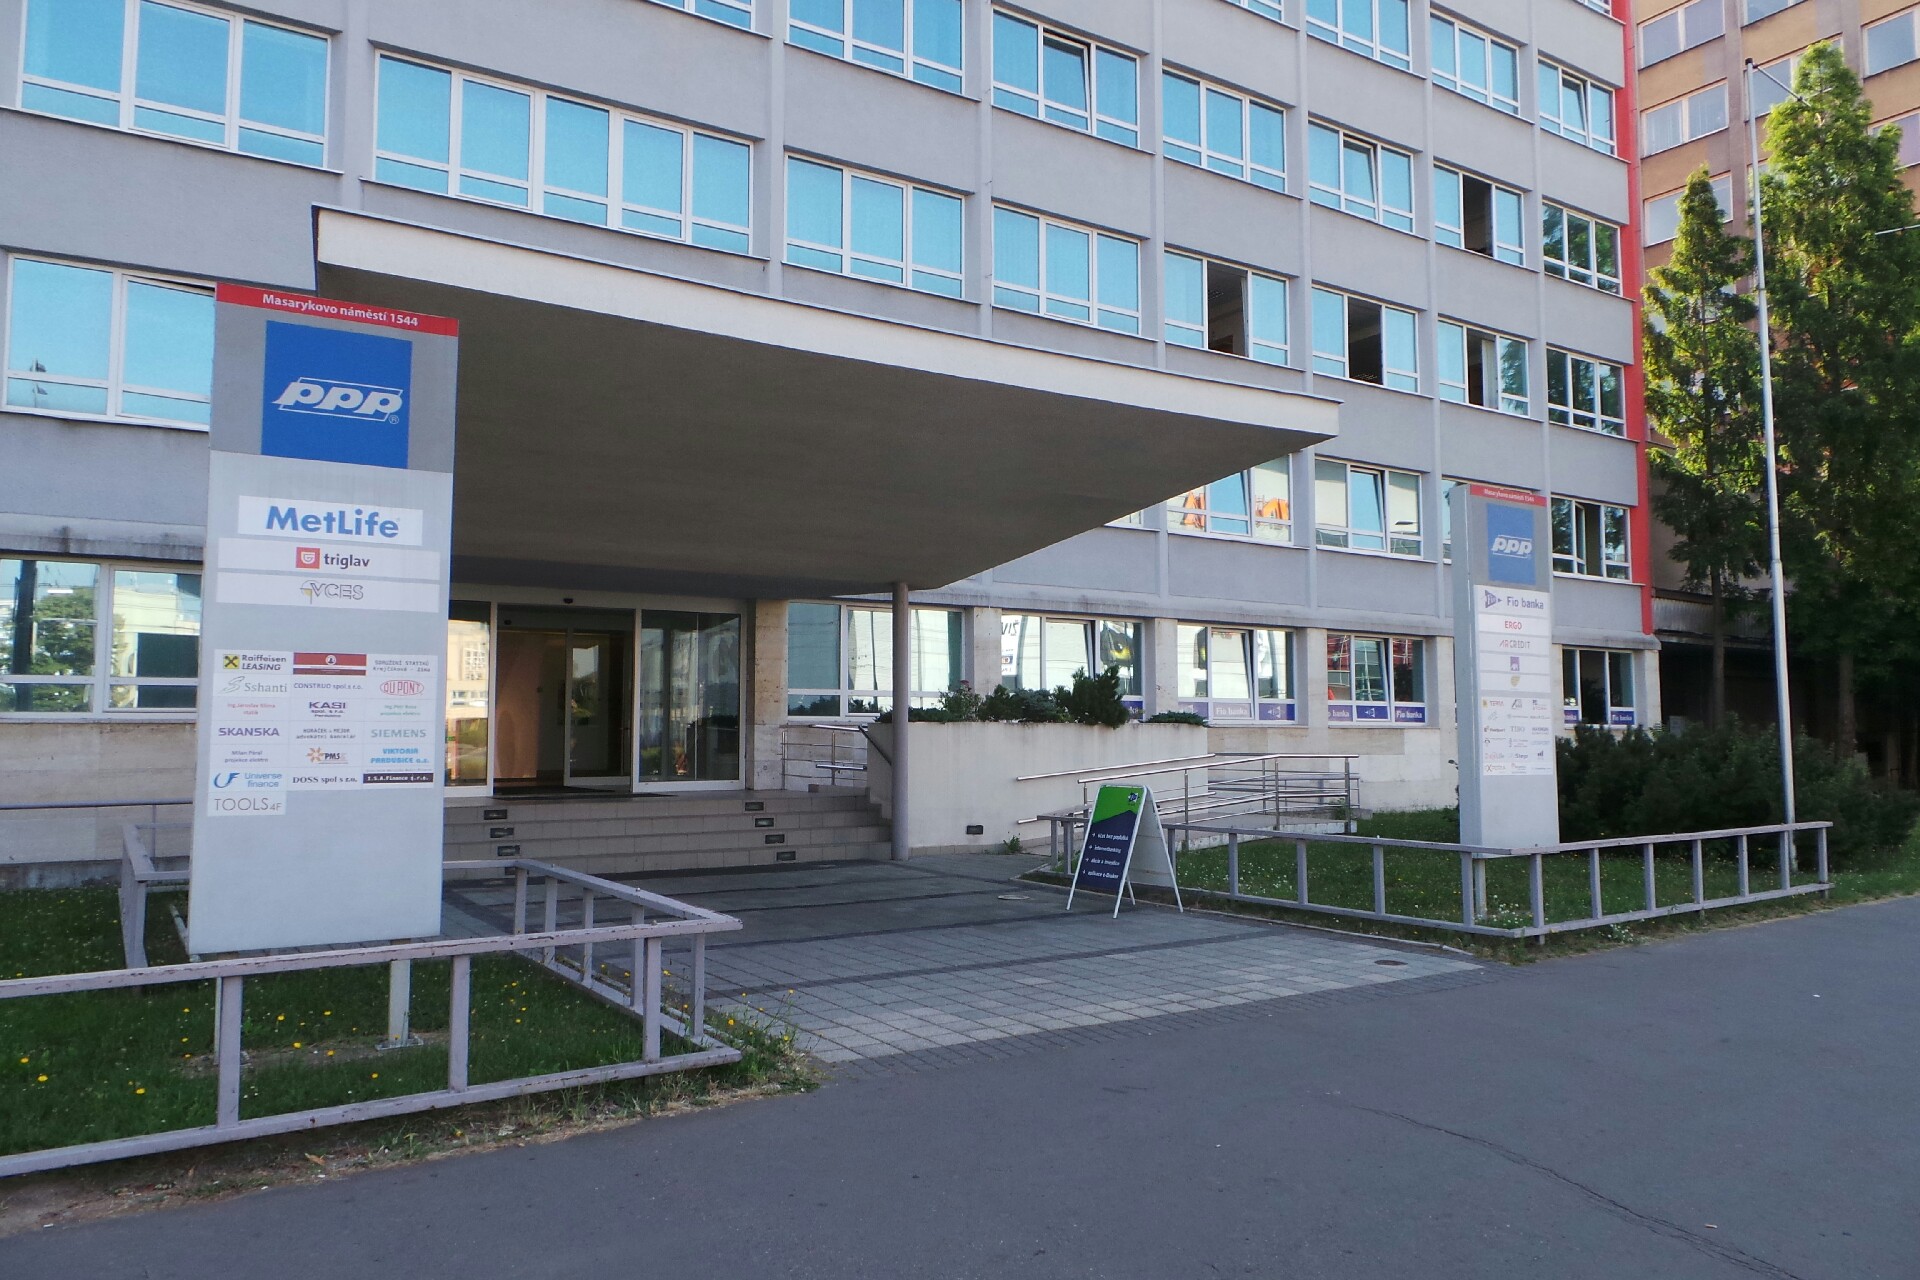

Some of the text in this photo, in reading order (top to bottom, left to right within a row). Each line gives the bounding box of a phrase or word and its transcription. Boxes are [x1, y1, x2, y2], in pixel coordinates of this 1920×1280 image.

[262, 293, 418, 326] Masarykovo náměstí 1544
[272, 381, 403, 414] ppp
[266, 505, 399, 538] MetLife
[1491, 537, 1533, 555] ppp
[324, 553, 370, 569] triglav
[310, 582, 364, 600] VCES
[1507, 596, 1544, 610] Fio banka
[1504, 620, 1522, 630] ERGO
[241, 654, 287, 662] Raiffeisen
[241, 663, 281, 671] LEASING
[243, 682, 288, 692] Sshanti
[1216, 707, 1227, 715] Fio
[1332, 710, 1350, 718] banka
[1396, 710, 1422, 719] Fio banka
[218, 727, 280, 737] SKANSKA
[371, 729, 427, 738] SIEMENS
